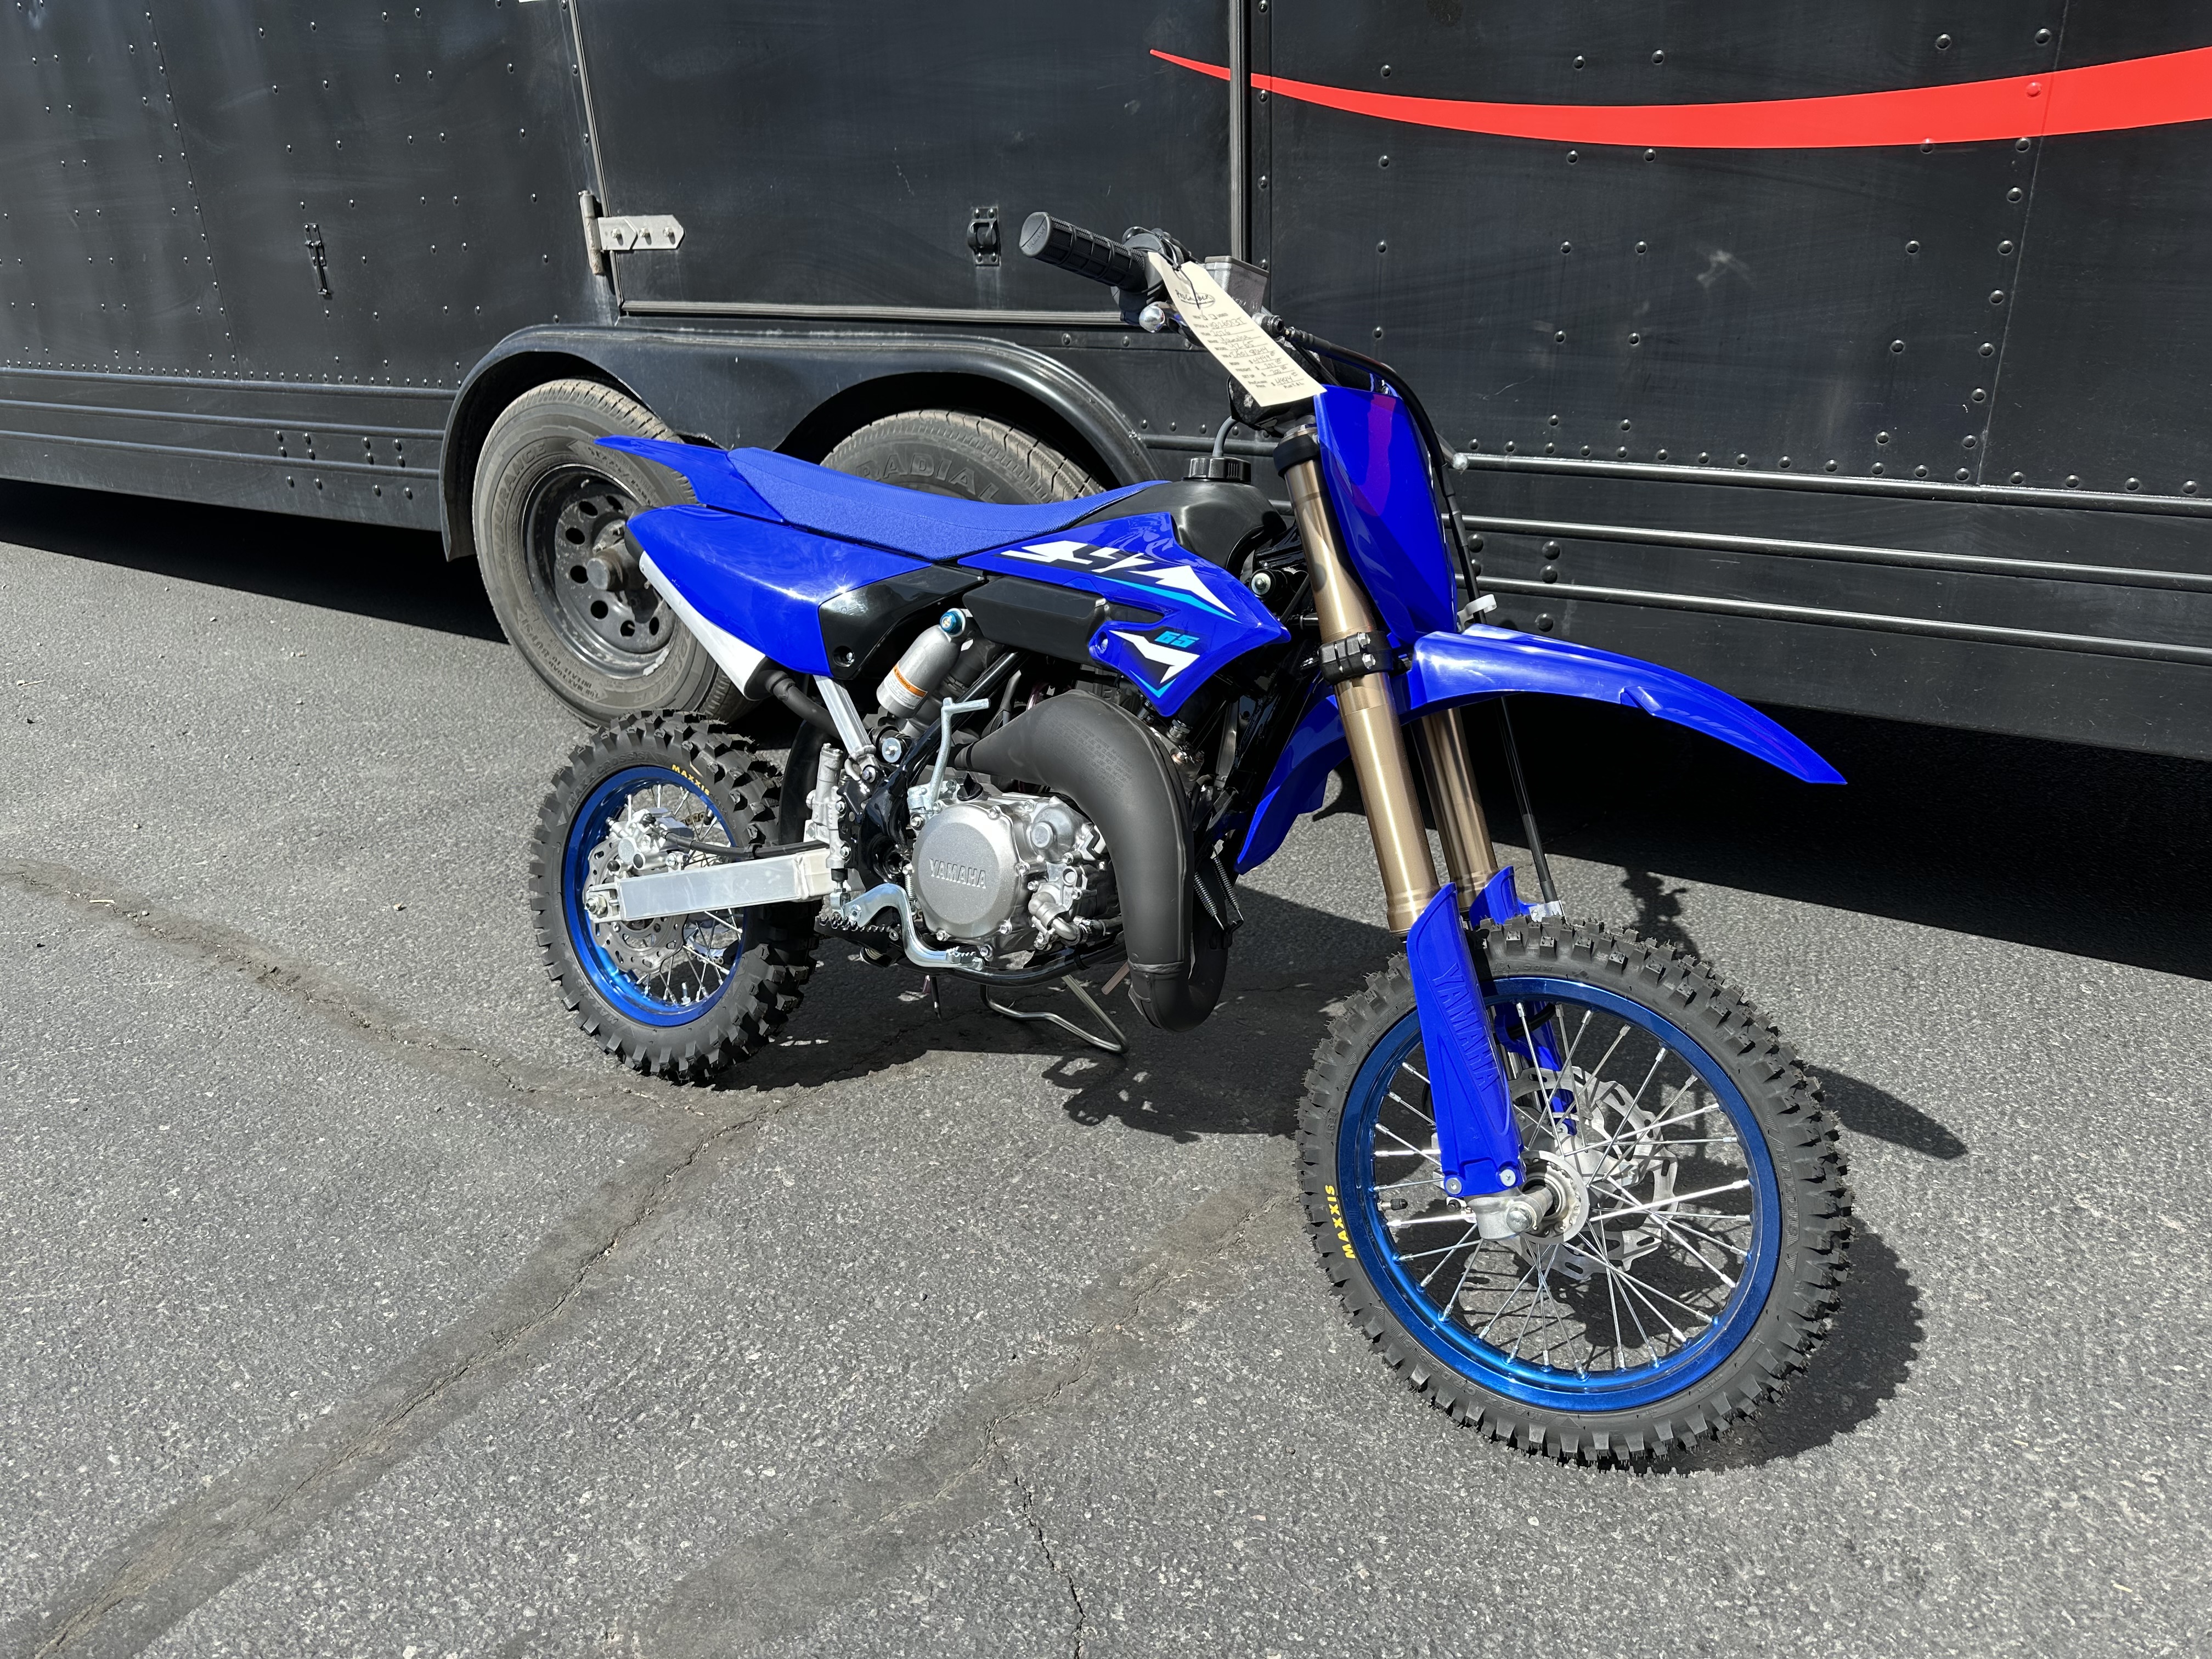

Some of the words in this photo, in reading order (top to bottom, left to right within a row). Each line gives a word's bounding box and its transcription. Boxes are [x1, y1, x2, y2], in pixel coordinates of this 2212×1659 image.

[1154, 630, 1200, 648] 65
[895, 672, 911, 689] WARNING
[672, 764, 710, 796] MAXXIS
[929, 858, 987, 889] YAMAHA
[1432, 962, 1502, 1092] YAMAHA
[1325, 1184, 1356, 1259] MAXXIS
